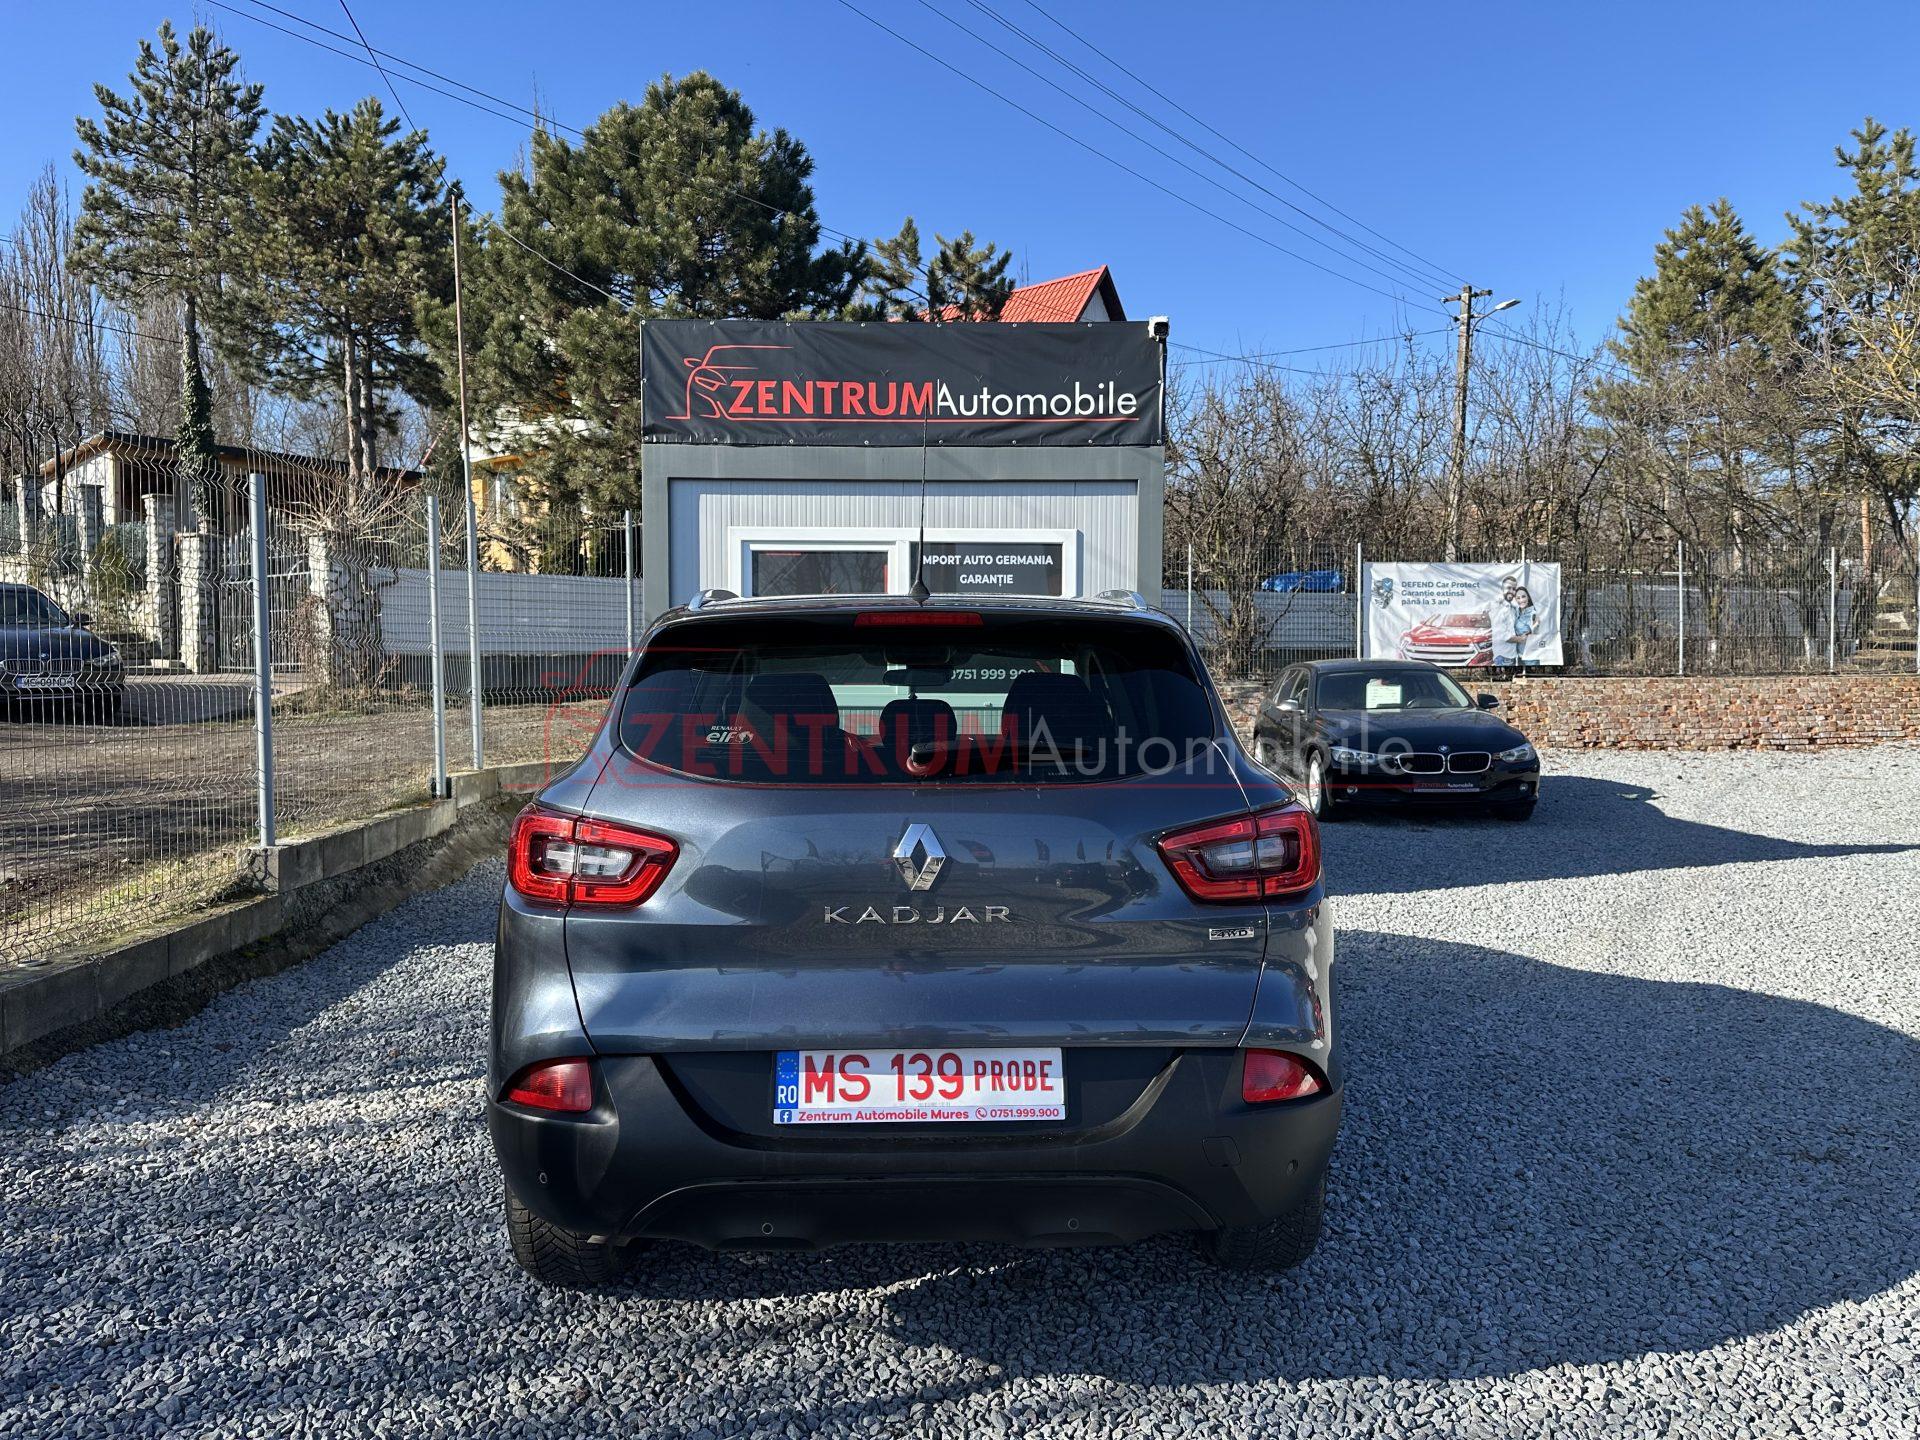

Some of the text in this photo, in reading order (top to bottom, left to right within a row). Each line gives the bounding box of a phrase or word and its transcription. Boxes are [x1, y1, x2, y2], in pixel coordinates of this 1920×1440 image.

[729, 380, 1138, 416] ZENTRUM Automobile
[921, 555, 1053, 565] MPORT AUTO GERMANIA
[1401, 581, 1434, 589] DEFEND
[1451, 581, 1480, 589] Protect
[1438, 597, 1450, 605] ani
[981, 669, 1006, 680] 999
[823, 905, 1013, 925] KADJAR
[777, 1053, 1054, 1104] RO MS 139 PROBE
[798, 1111, 853, 1122] Zentrum
[856, 1109, 928, 1121] Automobile
[931, 1109, 970, 1120] Mures
[989, 1107, 1060, 1119] 0751.999.900
